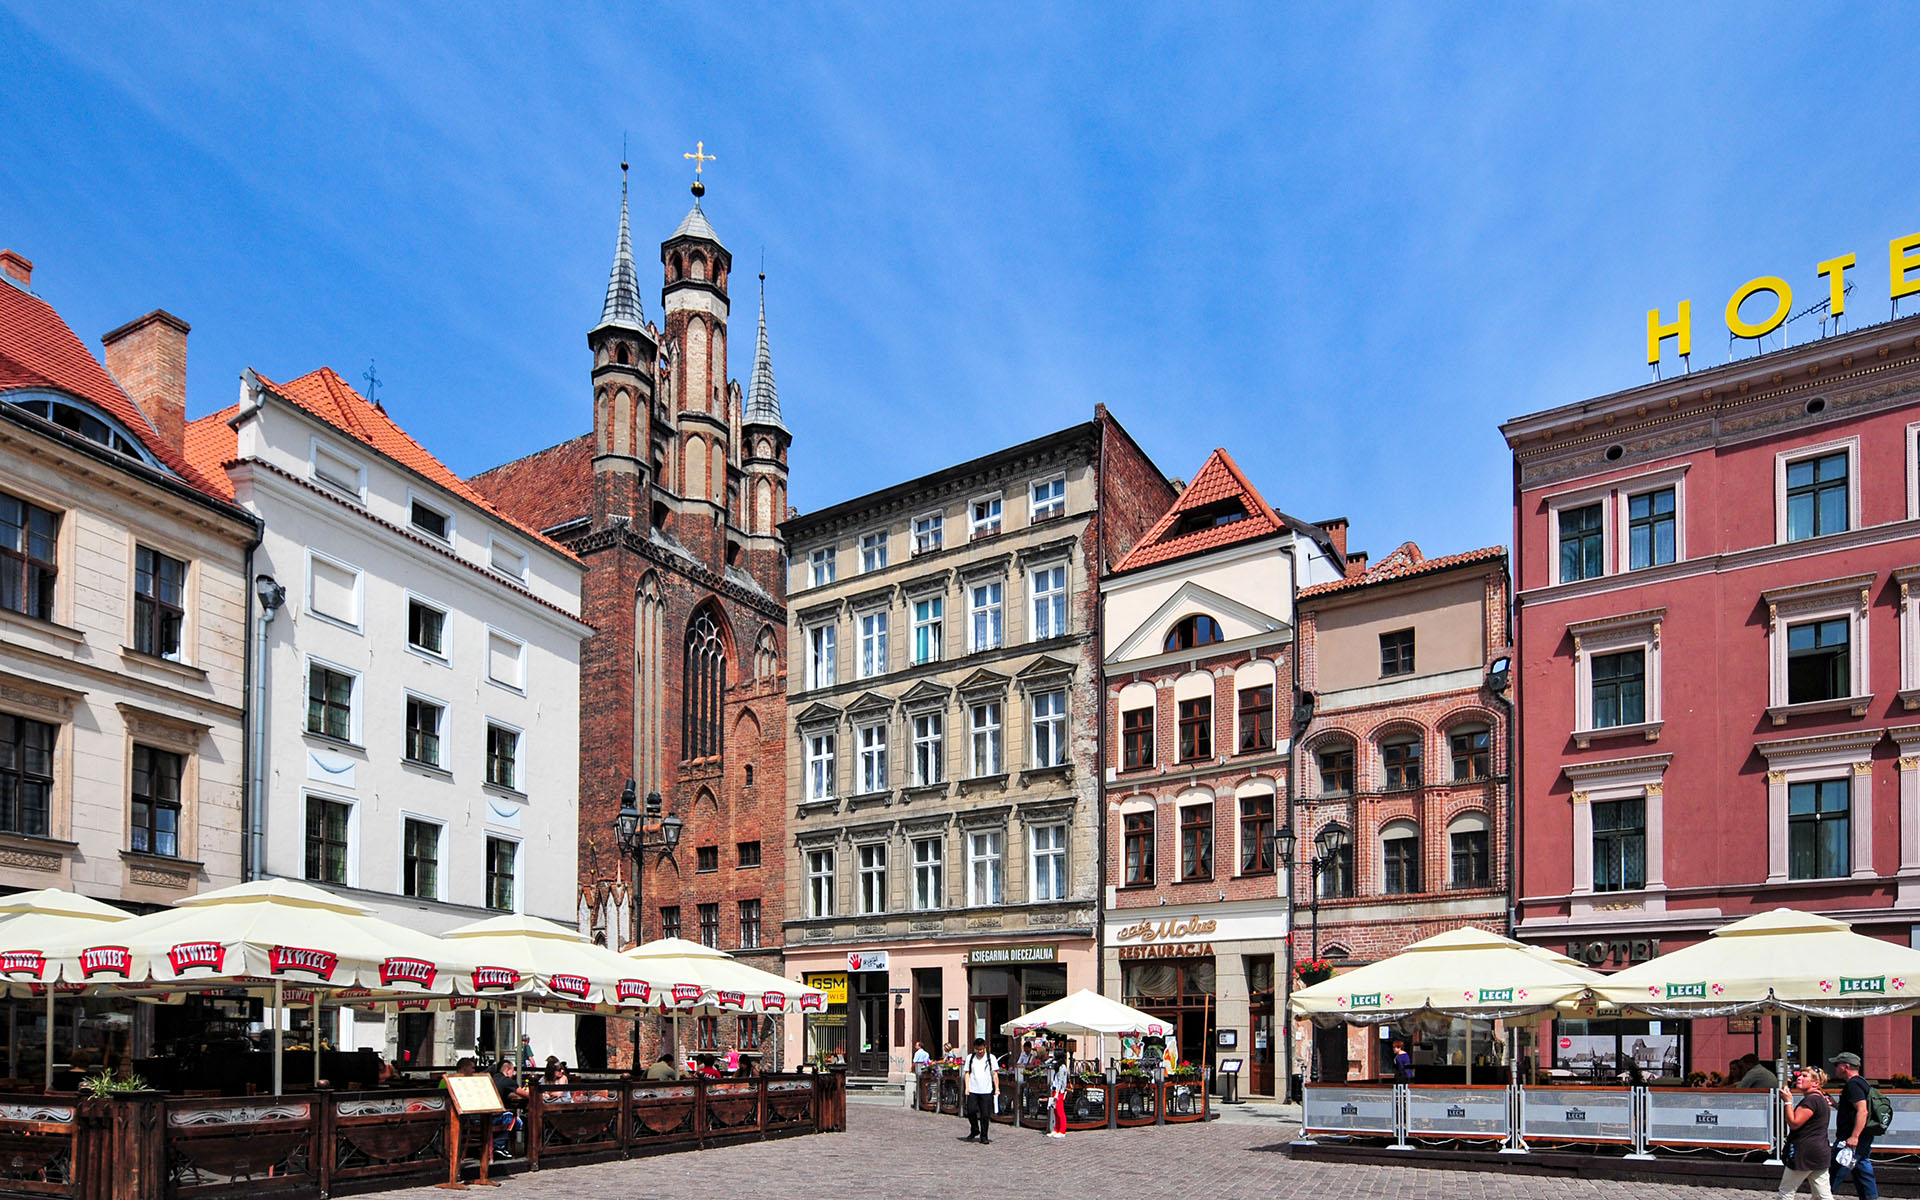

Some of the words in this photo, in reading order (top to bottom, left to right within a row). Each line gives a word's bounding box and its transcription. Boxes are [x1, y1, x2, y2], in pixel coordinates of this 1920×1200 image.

[1647, 232, 1920, 366] HOTE
[174, 945, 218, 965] ŻYWIEC
[278, 946, 331, 970] ŻYWIEC
[971, 950, 1009, 963] KSIĘGARNIA
[1011, 948, 1053, 961] DIECEZJALNA
[1119, 943, 1215, 958] RESTAURACJA
[1, 952, 38, 969] ŻYWIEC
[84, 949, 125, 968] ŻYWIEC
[387, 959, 431, 979] ŻYWIEC
[478, 967, 514, 984] ŻYWIEC
[555, 975, 585, 991] ŻYWIEC
[620, 980, 647, 995] ŻYWIEC
[812, 977, 844, 989] GSM
[1670, 985, 1702, 996] LECH
[1844, 980, 1880, 991] LECH
[1354, 996, 1378, 1005] LECH
[1482, 991, 1510, 1000] LECH
